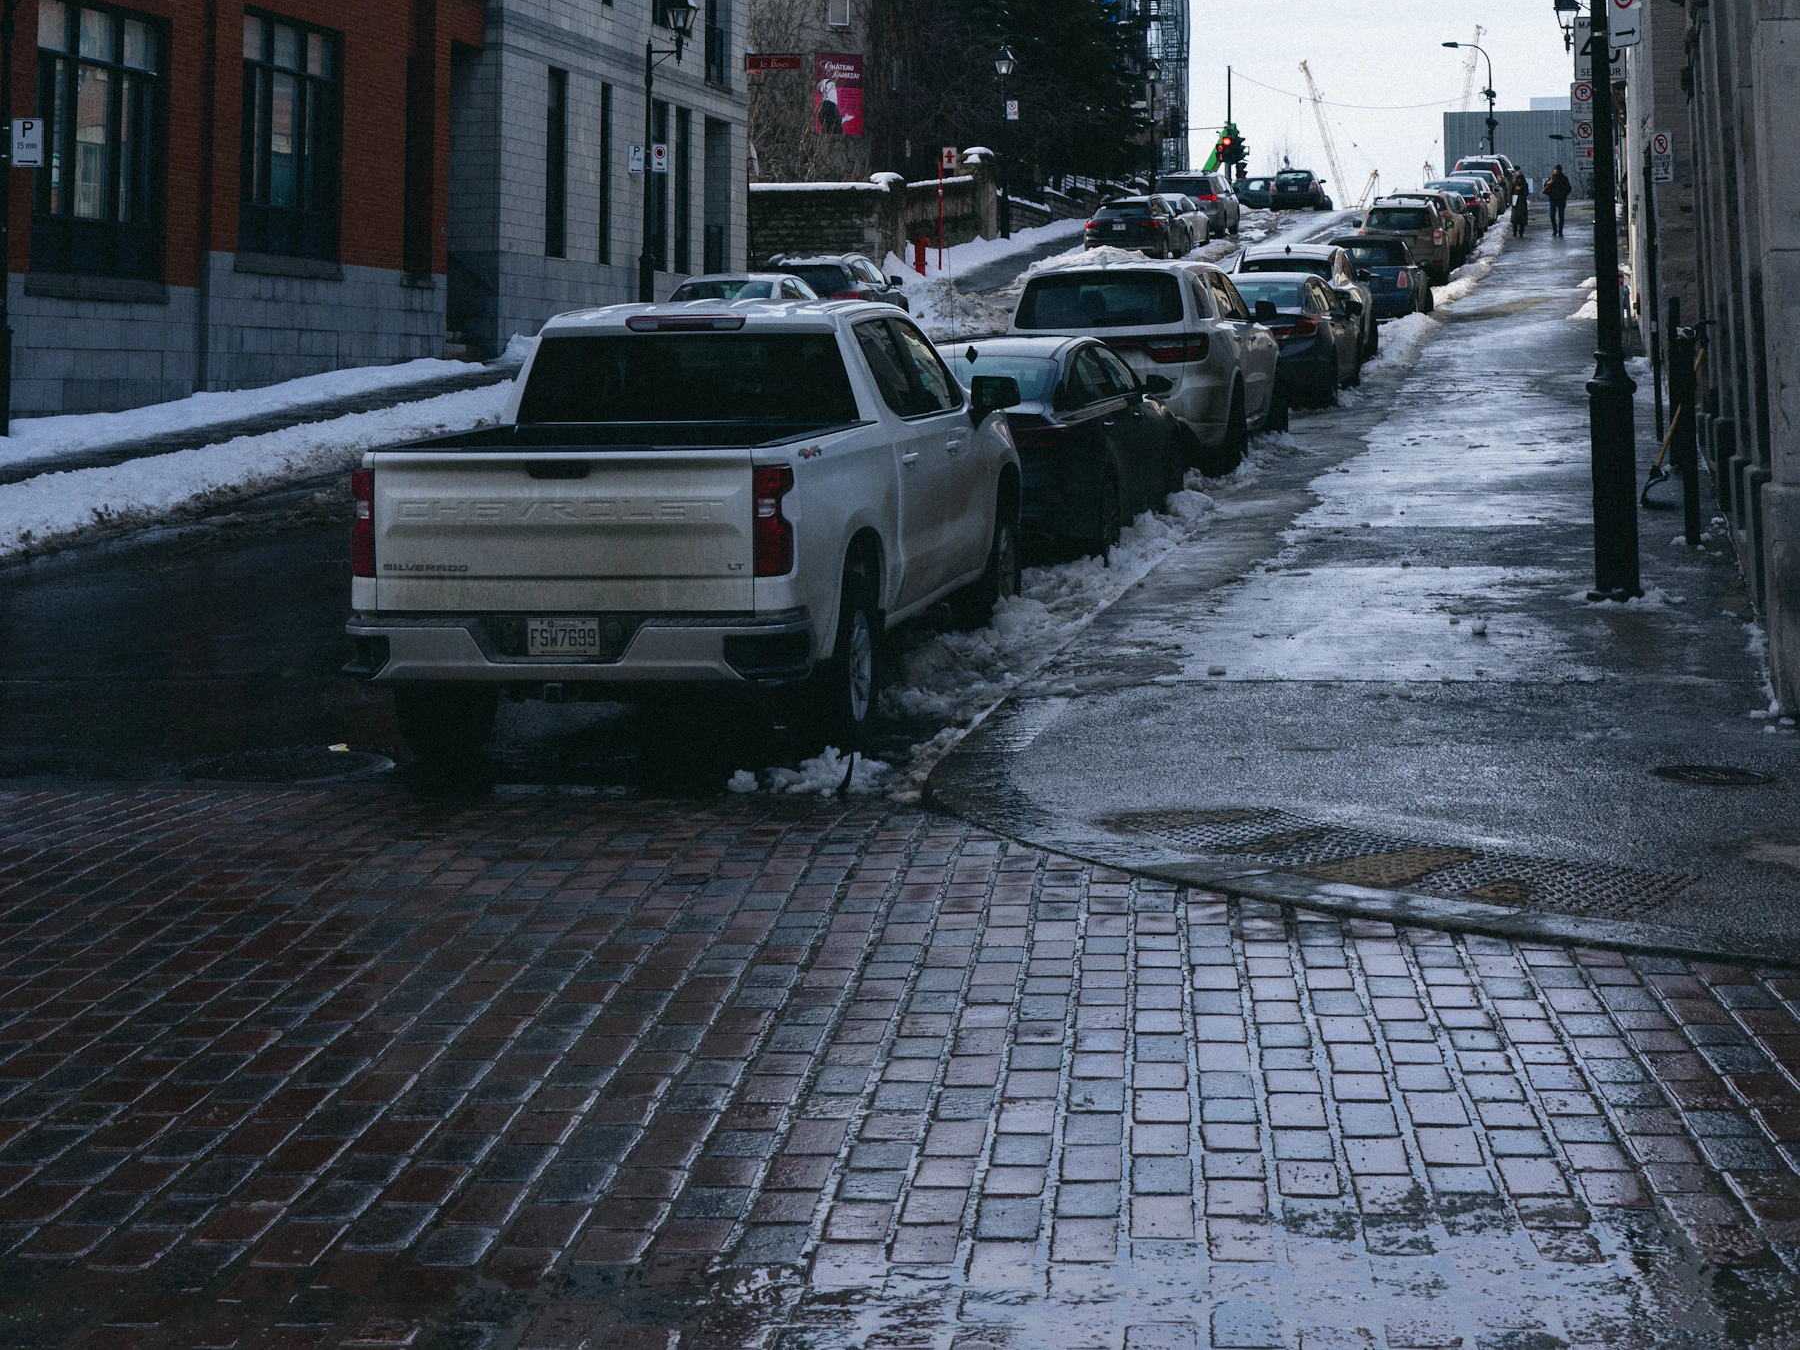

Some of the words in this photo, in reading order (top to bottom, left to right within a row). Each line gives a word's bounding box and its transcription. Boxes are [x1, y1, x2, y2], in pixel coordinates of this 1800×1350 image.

[22, 121, 33, 137] P
[634, 146, 640, 156] P
[397, 500, 725, 522] CHEVROLET
[382, 563, 469, 572] SILVERADO
[727, 563, 744, 571] LT
[530, 628, 596, 647] FSW7699
